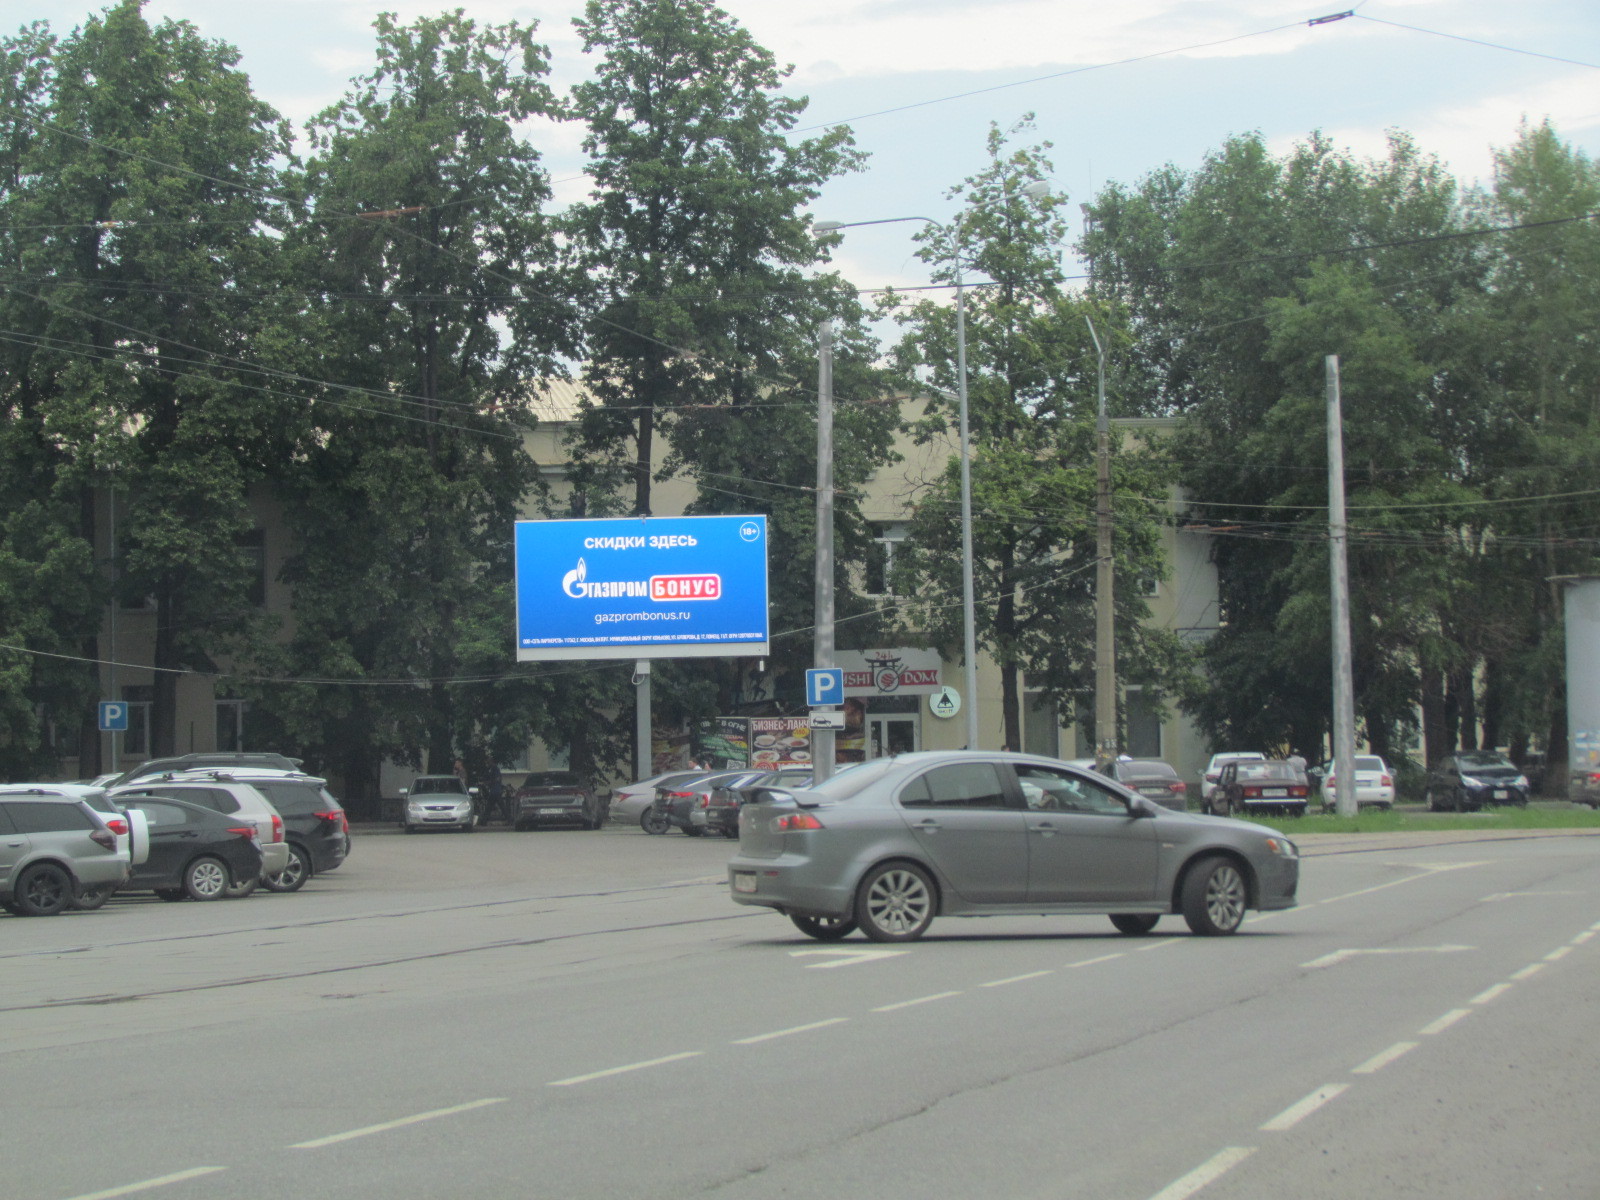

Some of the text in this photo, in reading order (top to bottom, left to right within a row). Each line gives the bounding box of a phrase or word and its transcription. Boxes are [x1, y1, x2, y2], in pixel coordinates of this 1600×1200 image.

[742, 527, 757, 536] 18+
[584, 535, 698, 551] СКИДКИ ЗДЕСЬ
[587, 579, 716, 598] ГАЗПРОМ БОНУС
[594, 611, 691, 625] gazprombonus.ru
[814, 672, 835, 702] P
[104, 704, 122, 727] P
